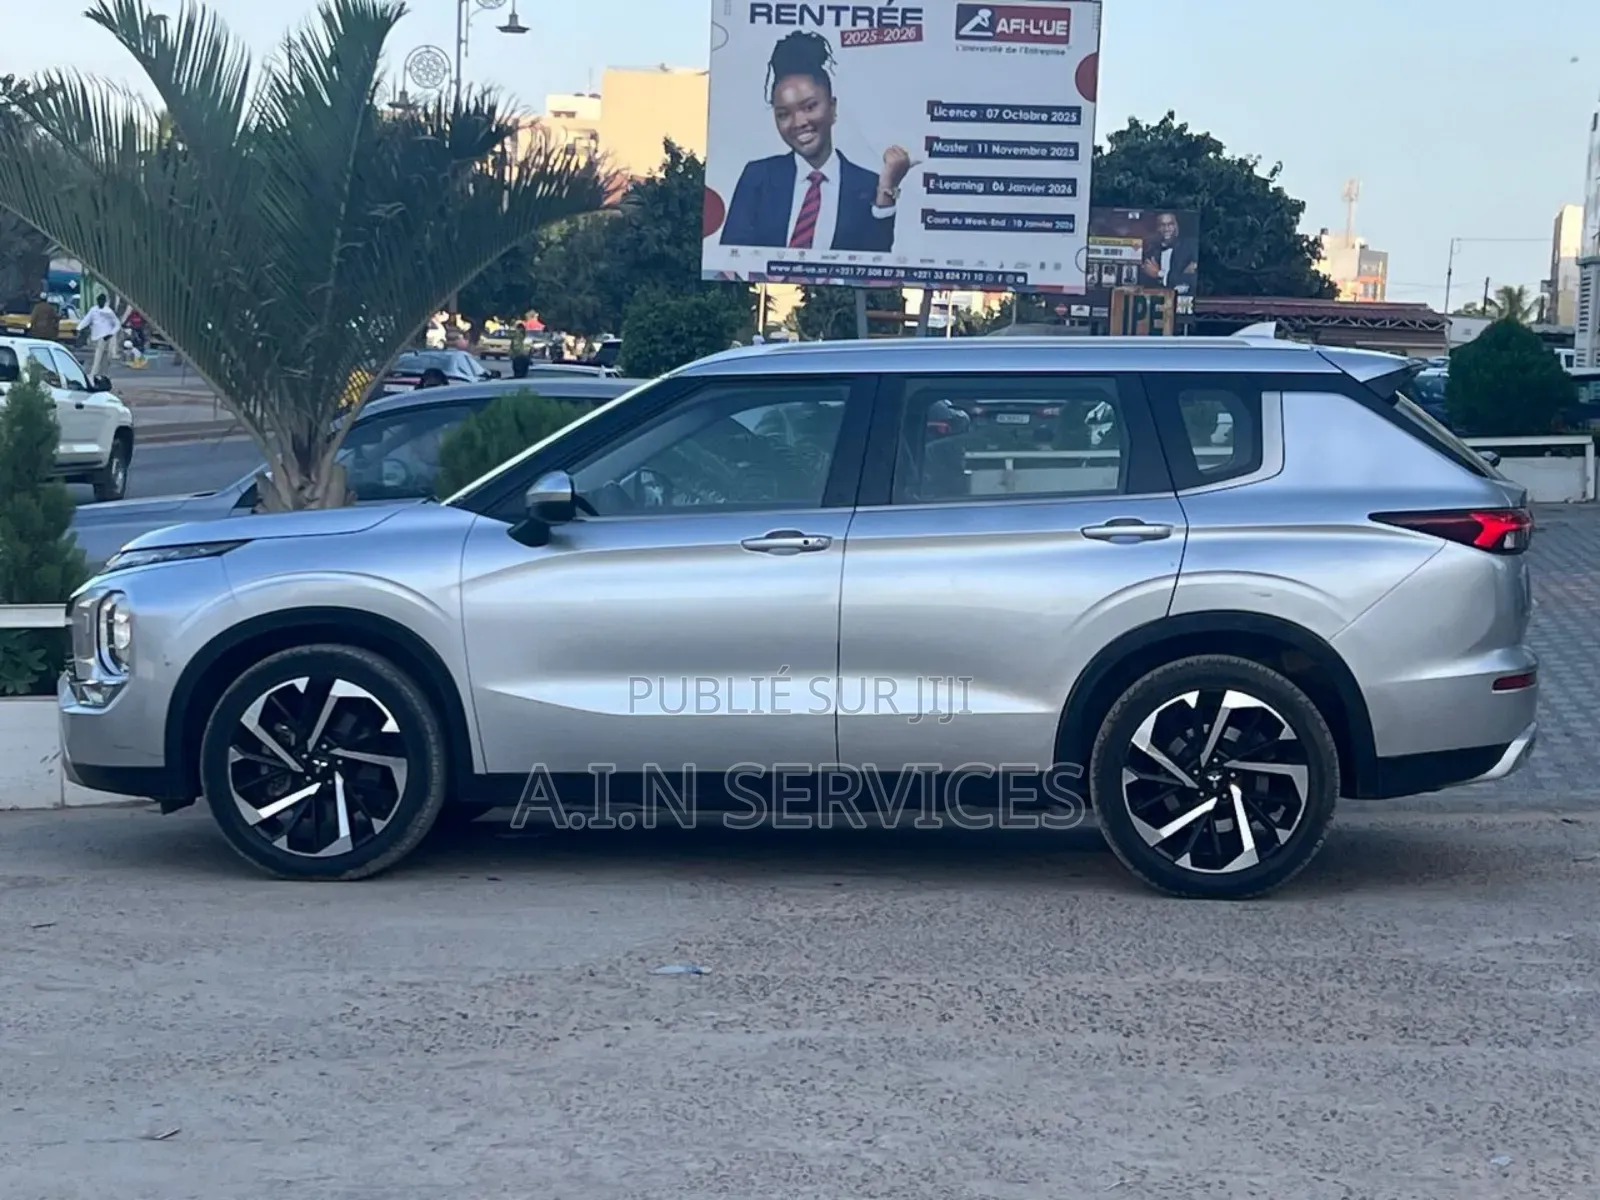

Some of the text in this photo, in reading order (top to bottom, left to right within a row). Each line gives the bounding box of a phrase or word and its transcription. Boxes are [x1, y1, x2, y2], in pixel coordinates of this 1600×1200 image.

[749, 0, 923, 29] RENTRÉE
[995, 17, 1068, 37] AFI-L'UE
[843, 27, 917, 46] 2025-2026
[1006, 46, 1017, 54] de
[933, 105, 978, 119] Licence
[986, 108, 999, 120] 07
[1002, 109, 1048, 122] Octobre
[1051, 111, 1077, 123] 2025
[932, 141, 969, 154] Master
[977, 143, 989, 154] 11
[992, 144, 1048, 157] Novembre
[1050, 146, 1075, 158] 2025
[929, 179, 985, 194] E-Learning
[992, 181, 1005, 192] 06
[1008, 182, 1046, 193] Janvier
[1048, 183, 1073, 195] 2026
[926, 215, 950, 226] Cours
[951, 216, 963, 226] du
[1024, 220, 1053, 230] Janvier
[1055, 221, 1073, 230] 2026
